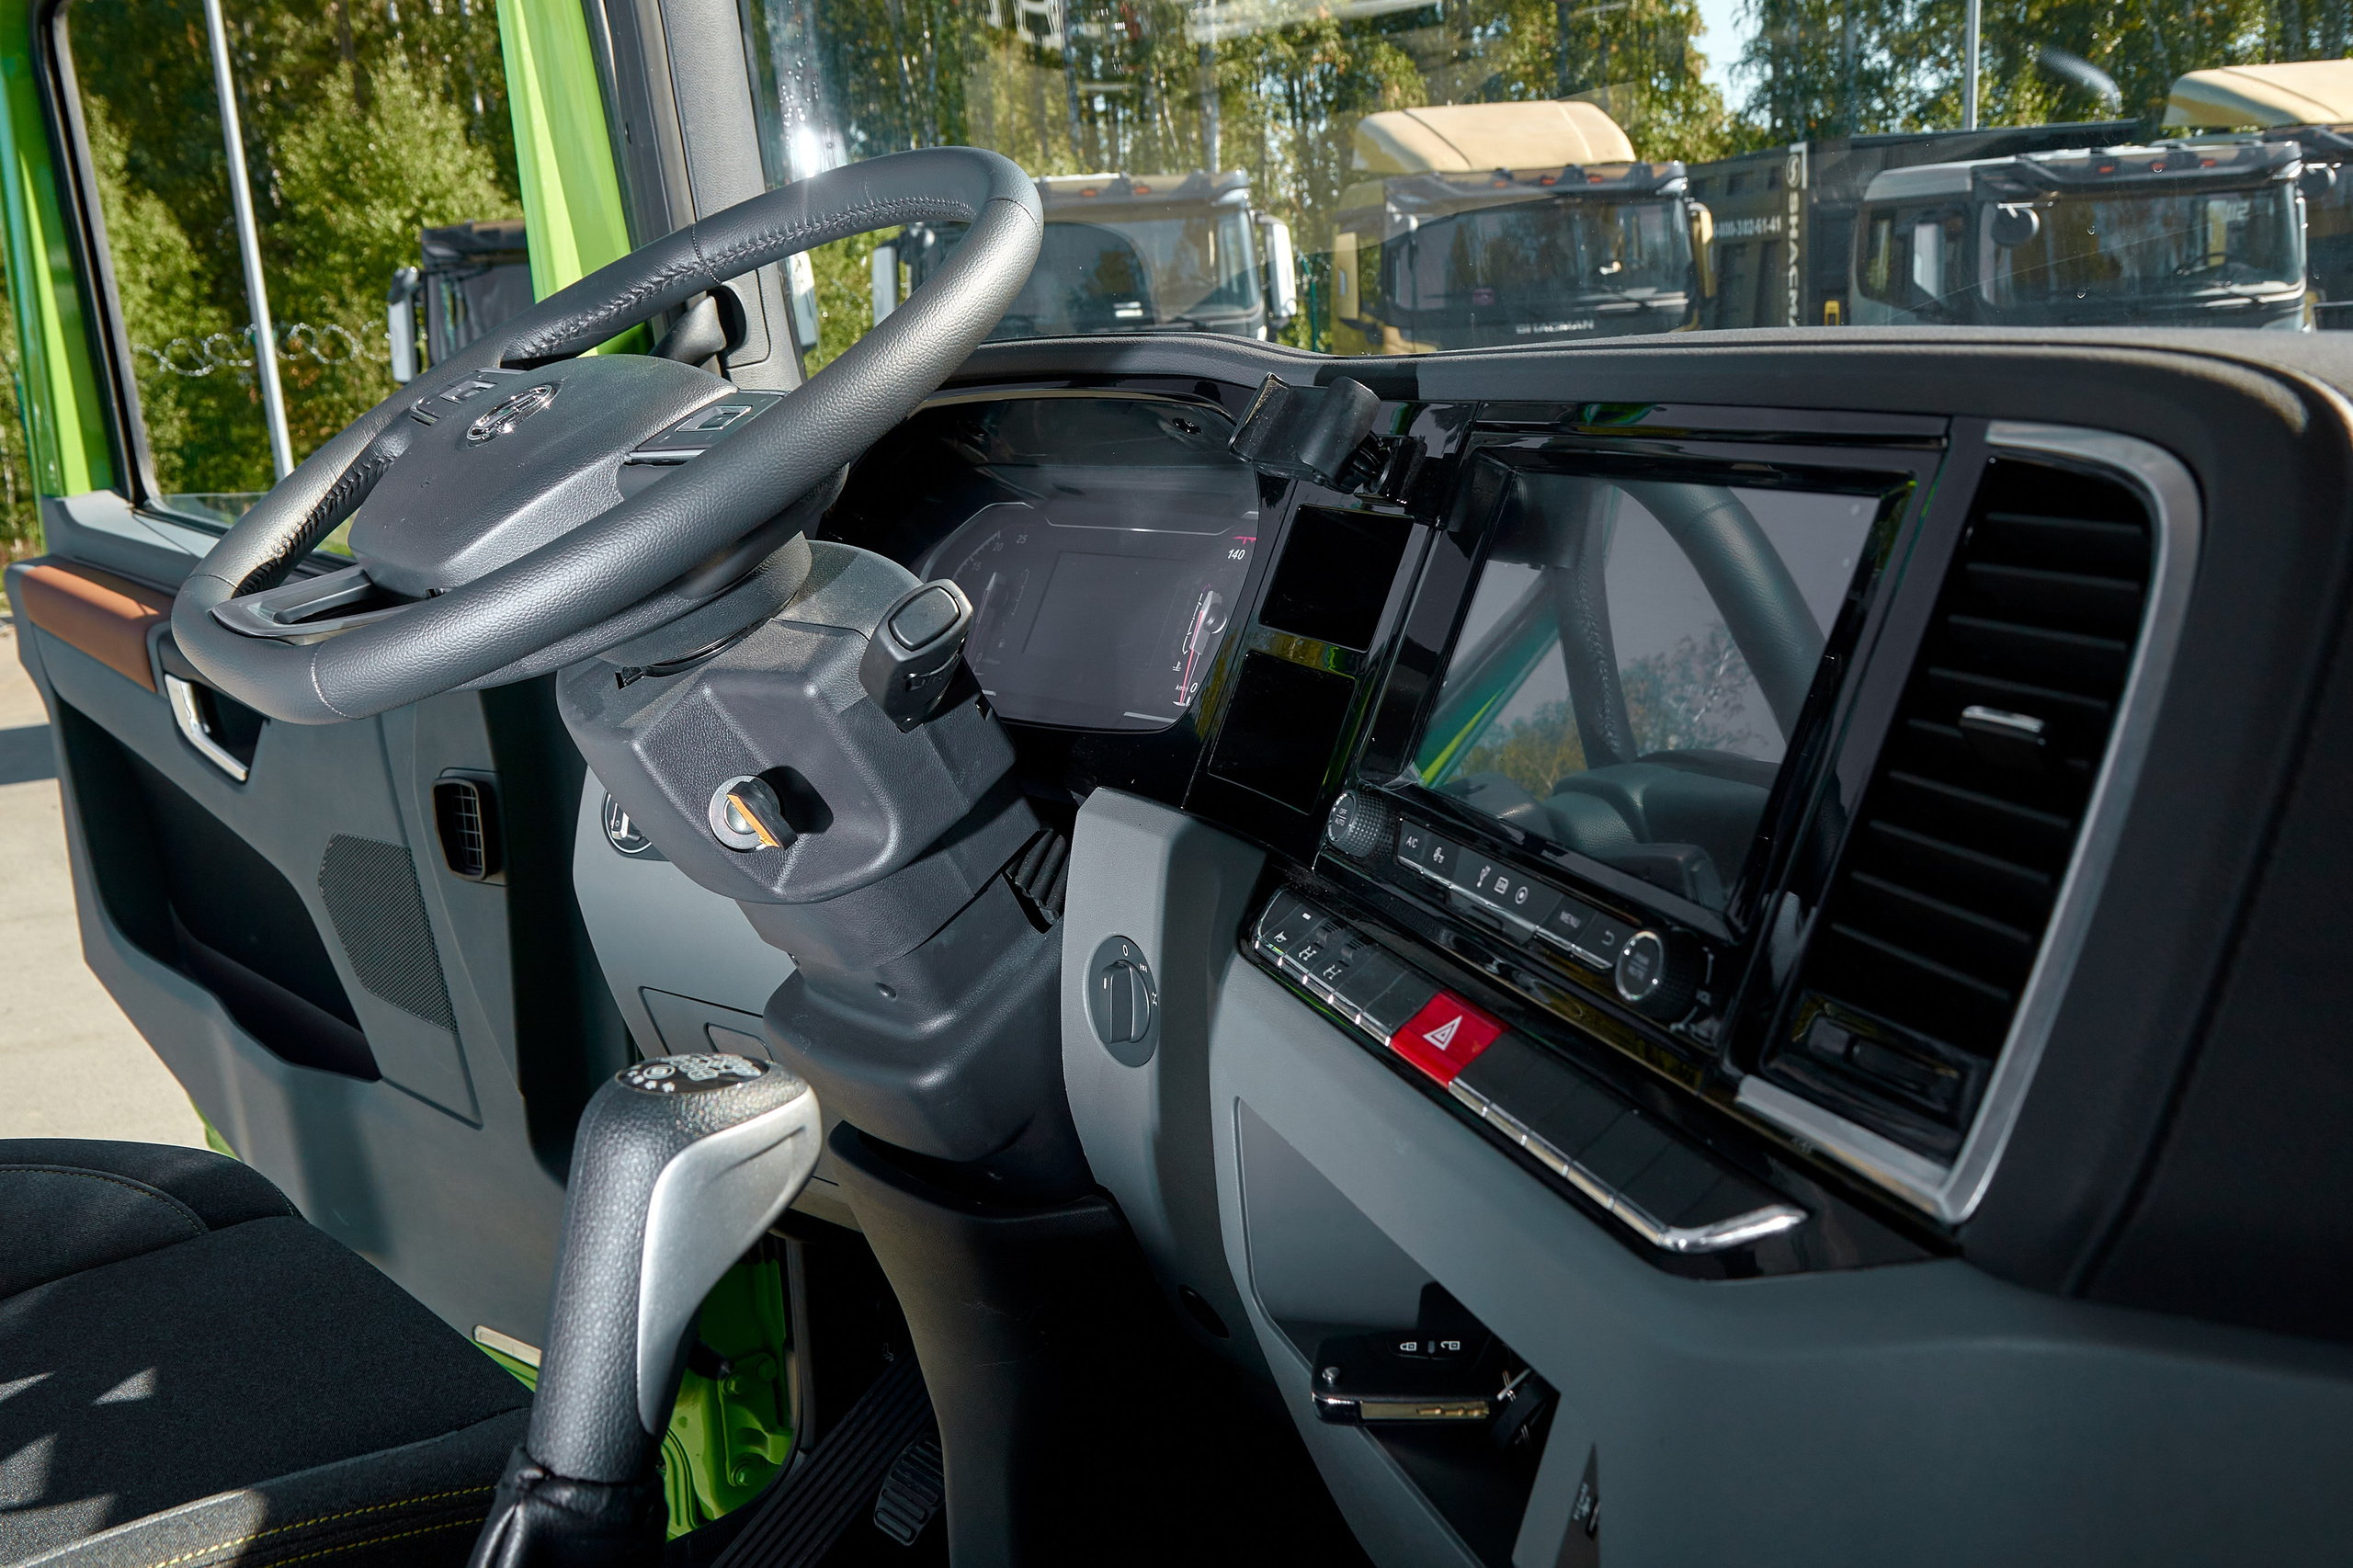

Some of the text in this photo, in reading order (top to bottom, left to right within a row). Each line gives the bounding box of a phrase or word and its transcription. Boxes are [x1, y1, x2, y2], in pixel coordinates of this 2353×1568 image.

[1016, 534, 1028, 544] 25
[993, 542, 1004, 552] 20
[1227, 549, 1245, 561] 140
[1189, 682, 1198, 693] 0
[1335, 818, 1346, 826] AUTO
